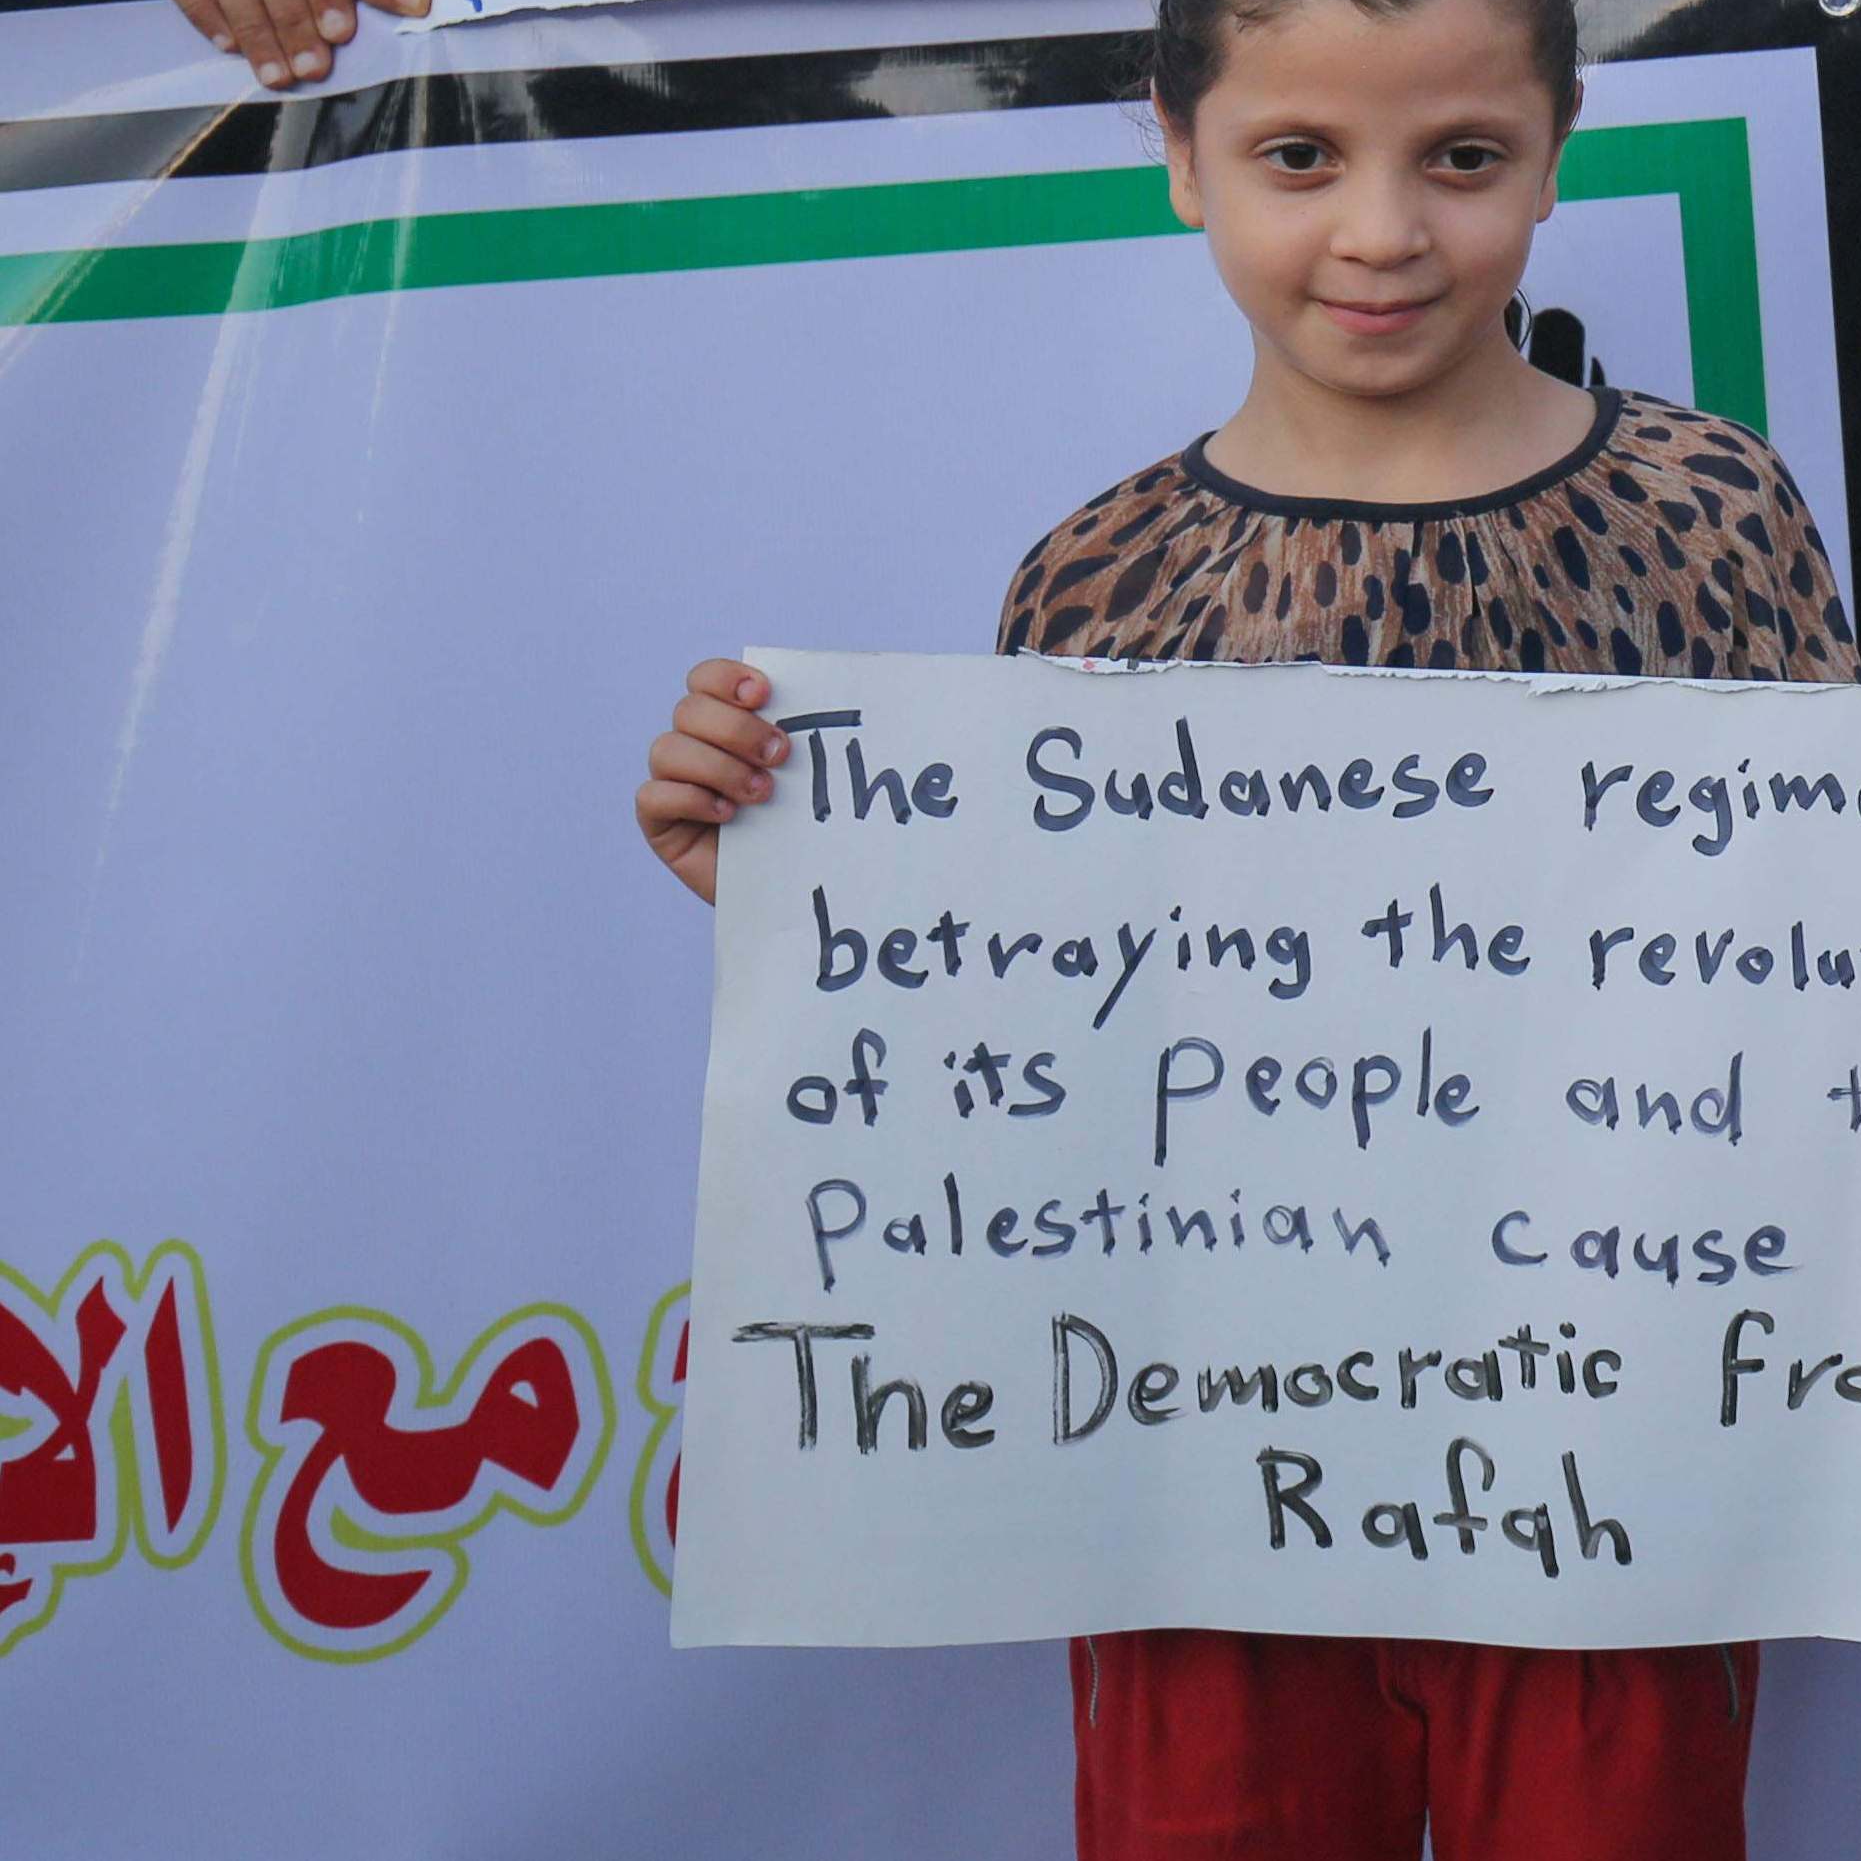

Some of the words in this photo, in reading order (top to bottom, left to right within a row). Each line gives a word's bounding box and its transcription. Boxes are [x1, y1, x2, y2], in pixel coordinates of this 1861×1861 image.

[775, 710, 958, 825] The
[1026, 716, 1494, 832] Sudanese
[812, 885, 1311, 1030] betraying
[1361, 882, 1531, 976] the
[786, 1028, 889, 1127] of
[943, 1042, 1067, 1119] its
[1154, 1026, 1480, 1168] people
[1566, 1051, 1743, 1147] and
[1492, 1210, 1797, 1289] cause
[731, 1322, 995, 1456] The
[1052, 1311, 1622, 1446] Democratic
[264, 1326, 590, 1637] مع
[1256, 1437, 1632, 1579] Rafah
